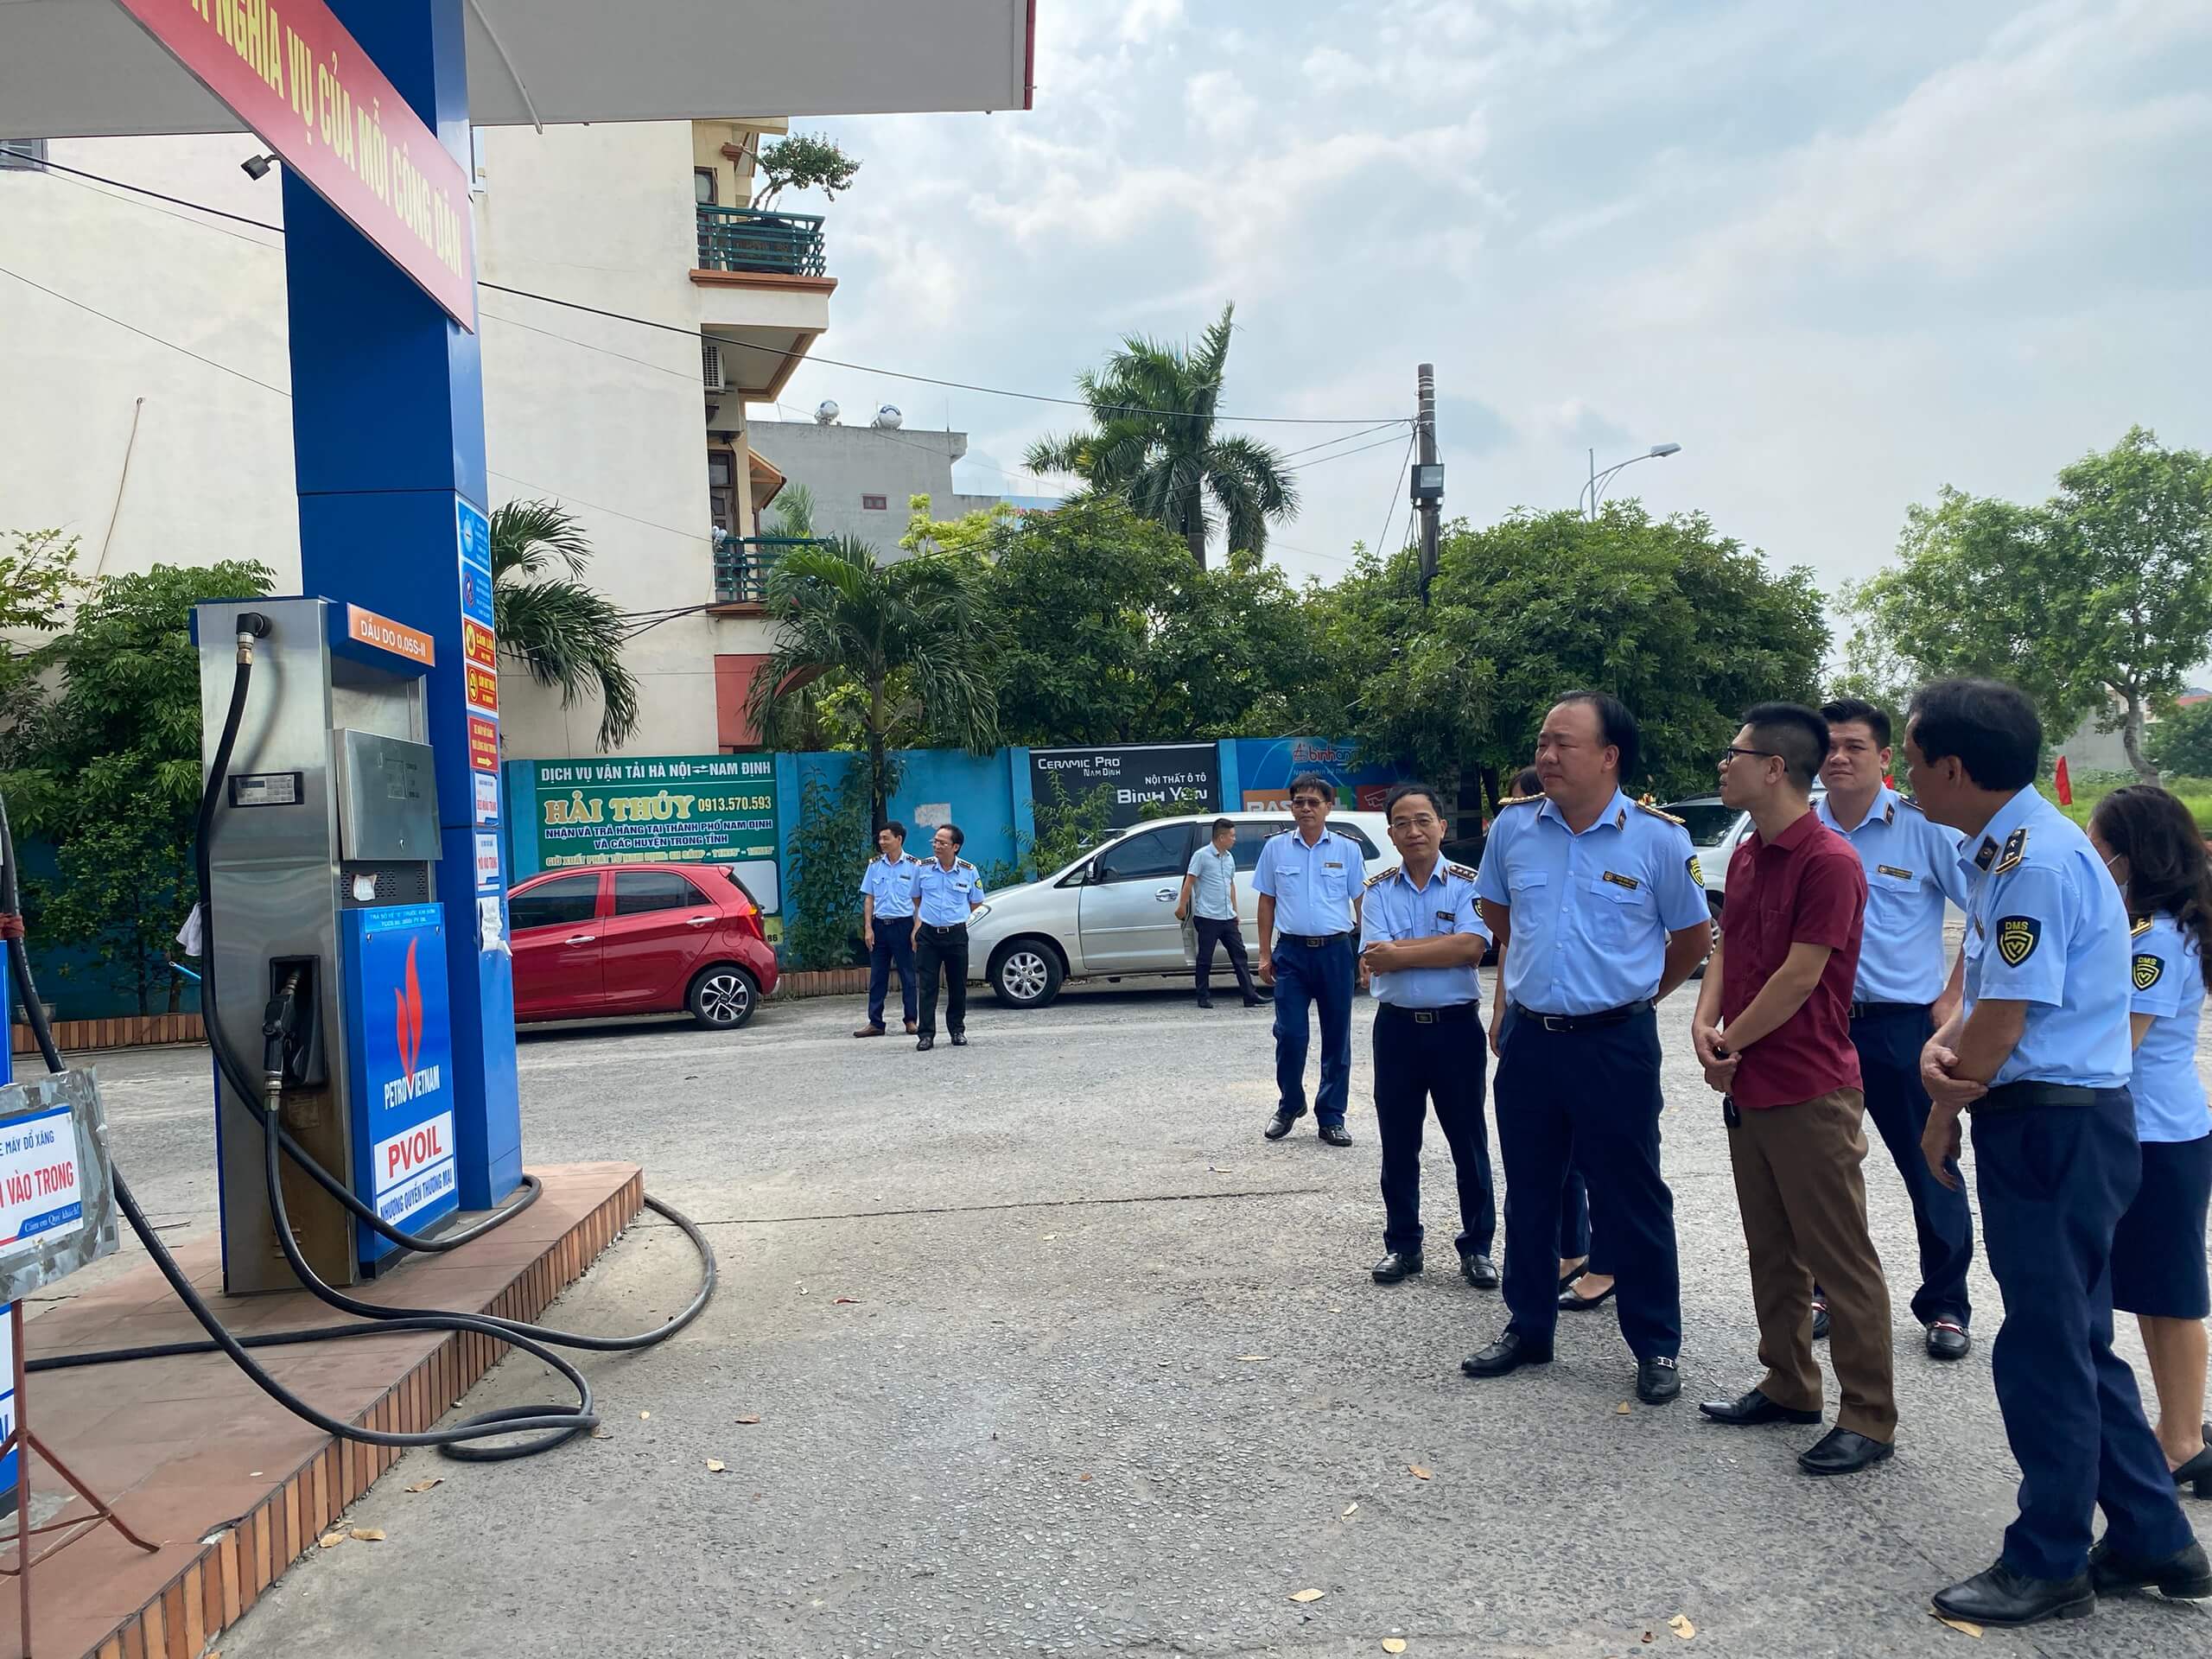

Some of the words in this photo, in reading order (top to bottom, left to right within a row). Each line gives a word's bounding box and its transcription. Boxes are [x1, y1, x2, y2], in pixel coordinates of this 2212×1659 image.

[287, 24, 314, 145] VỤ
[318, 50, 355, 171] CỦA
[358, 96, 391, 207] MỖI
[392, 141, 433, 249] CÔNG
[434, 188, 463, 279] DÂN
[360, 616, 380, 641] DẦU
[541, 766, 572, 784] DỊCH
[575, 766, 592, 782] VỤ
[596, 764, 622, 781] VẬN
[625, 761, 645, 778] TẢI
[649, 762, 666, 778] HÀ
[670, 761, 690, 779] NỘI
[709, 762, 739, 776] NAM
[741, 761, 771, 777] ĐỊNH
[1145, 774, 1160, 785] NỘI
[1162, 772, 1185, 784] THẤT
[1187, 772, 1193, 783] Ô
[1195, 772, 1207, 782] TÔ
[543, 790, 604, 824] HẢI
[608, 790, 696, 823] THÚY
[697, 795, 772, 812] 0913.570.593
[545, 827, 575, 840] NHẬN
[577, 826, 593, 836] VÀ
[594, 824, 613, 836] TRẢ
[615, 823, 645, 836] HÀNG
[645, 823, 664, 836] TẠI
[665, 822, 698, 834] THÀNH
[700, 818, 722, 831] PHỐ
[722, 820, 747, 830] NAM
[747, 819, 773, 831] ĐỊNH
[594, 838, 609, 850] VÀ
[610, 836, 632, 849] CÁC
[633, 834, 667, 849] HUYỆN
[669, 835, 703, 846] TRONG
[705, 833, 728, 845] TỈNH
[2005, 921, 2029, 931] DMS
[2138, 957, 2158, 966] DMS
[384, 1064, 441, 1110] PETROVIETNAM
[5, 1136, 21, 1155] MÁY
[7, 1169, 32, 1205] VÀO
[35, 1160, 74, 1197] TRONG
